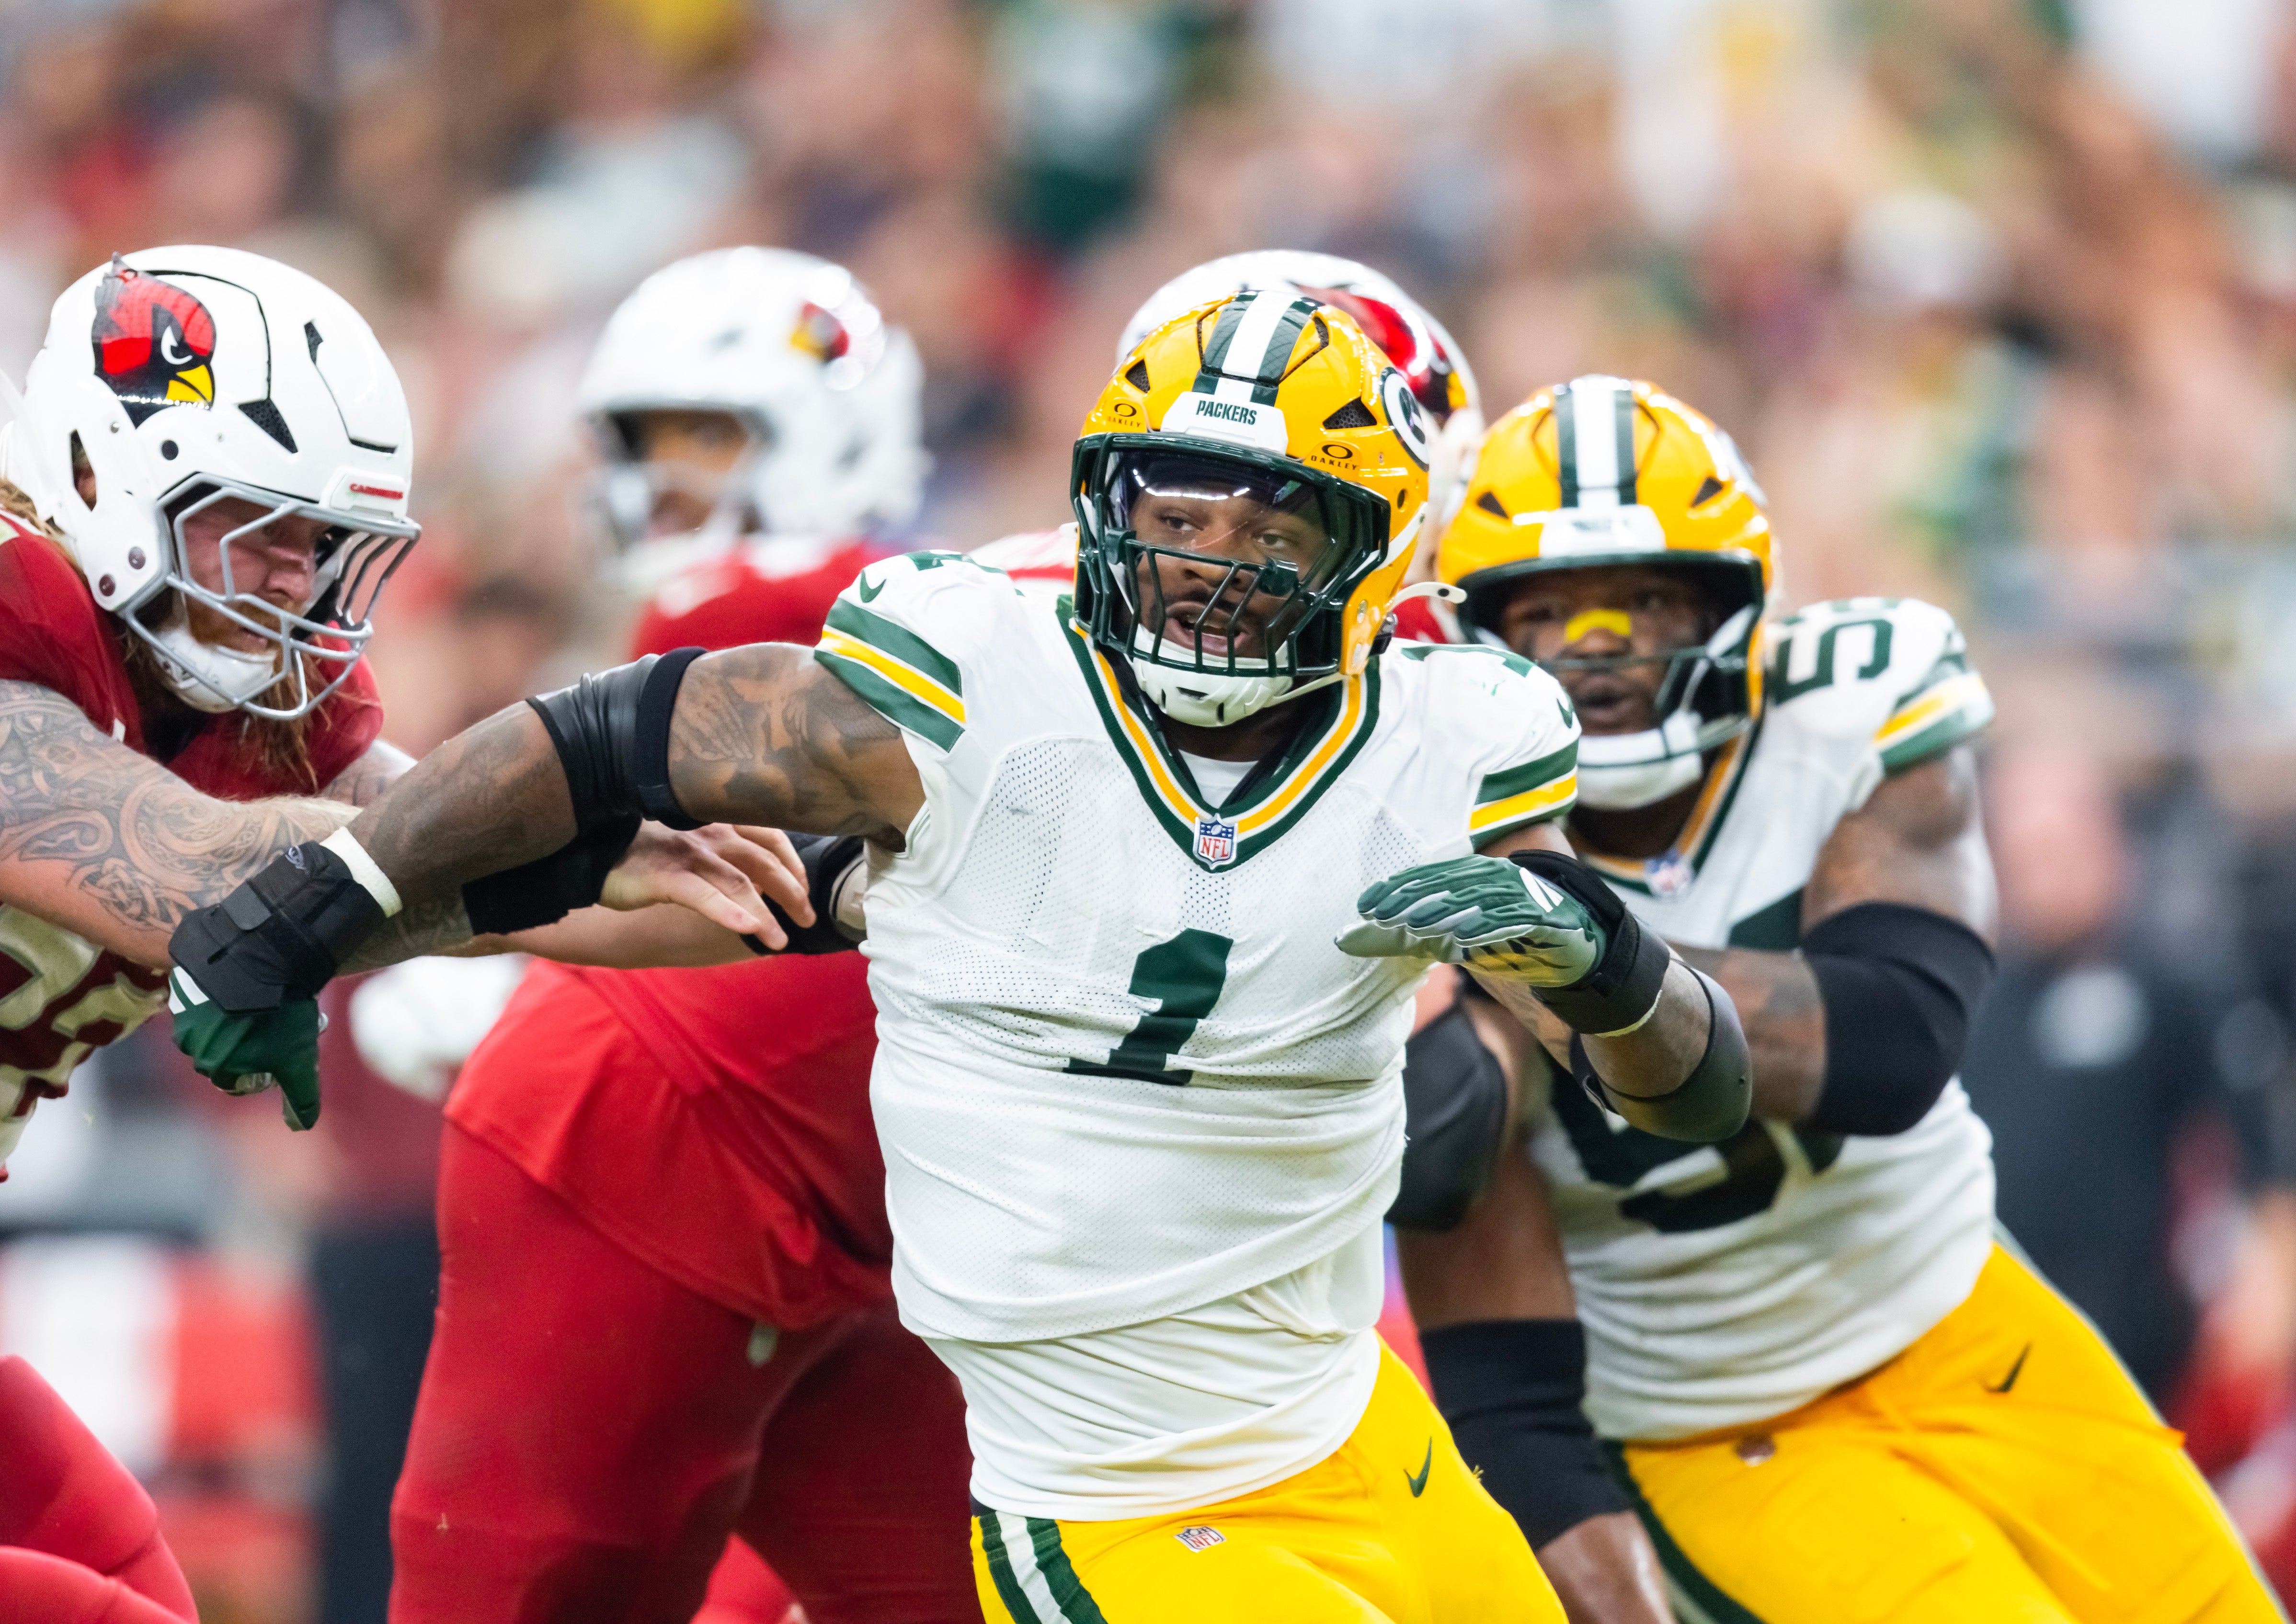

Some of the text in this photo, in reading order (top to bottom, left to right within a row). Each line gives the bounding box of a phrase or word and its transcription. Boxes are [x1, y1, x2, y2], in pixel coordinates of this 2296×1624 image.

[1195, 399, 1257, 425] PACKERS
[1107, 416, 1141, 428] OAKLEY
[1310, 455, 1358, 470] OAKLEY
[1200, 836, 1229, 859] NFL
[1062, 927, 1234, 1087] 1
[1189, 1532, 1220, 1547] NFL
